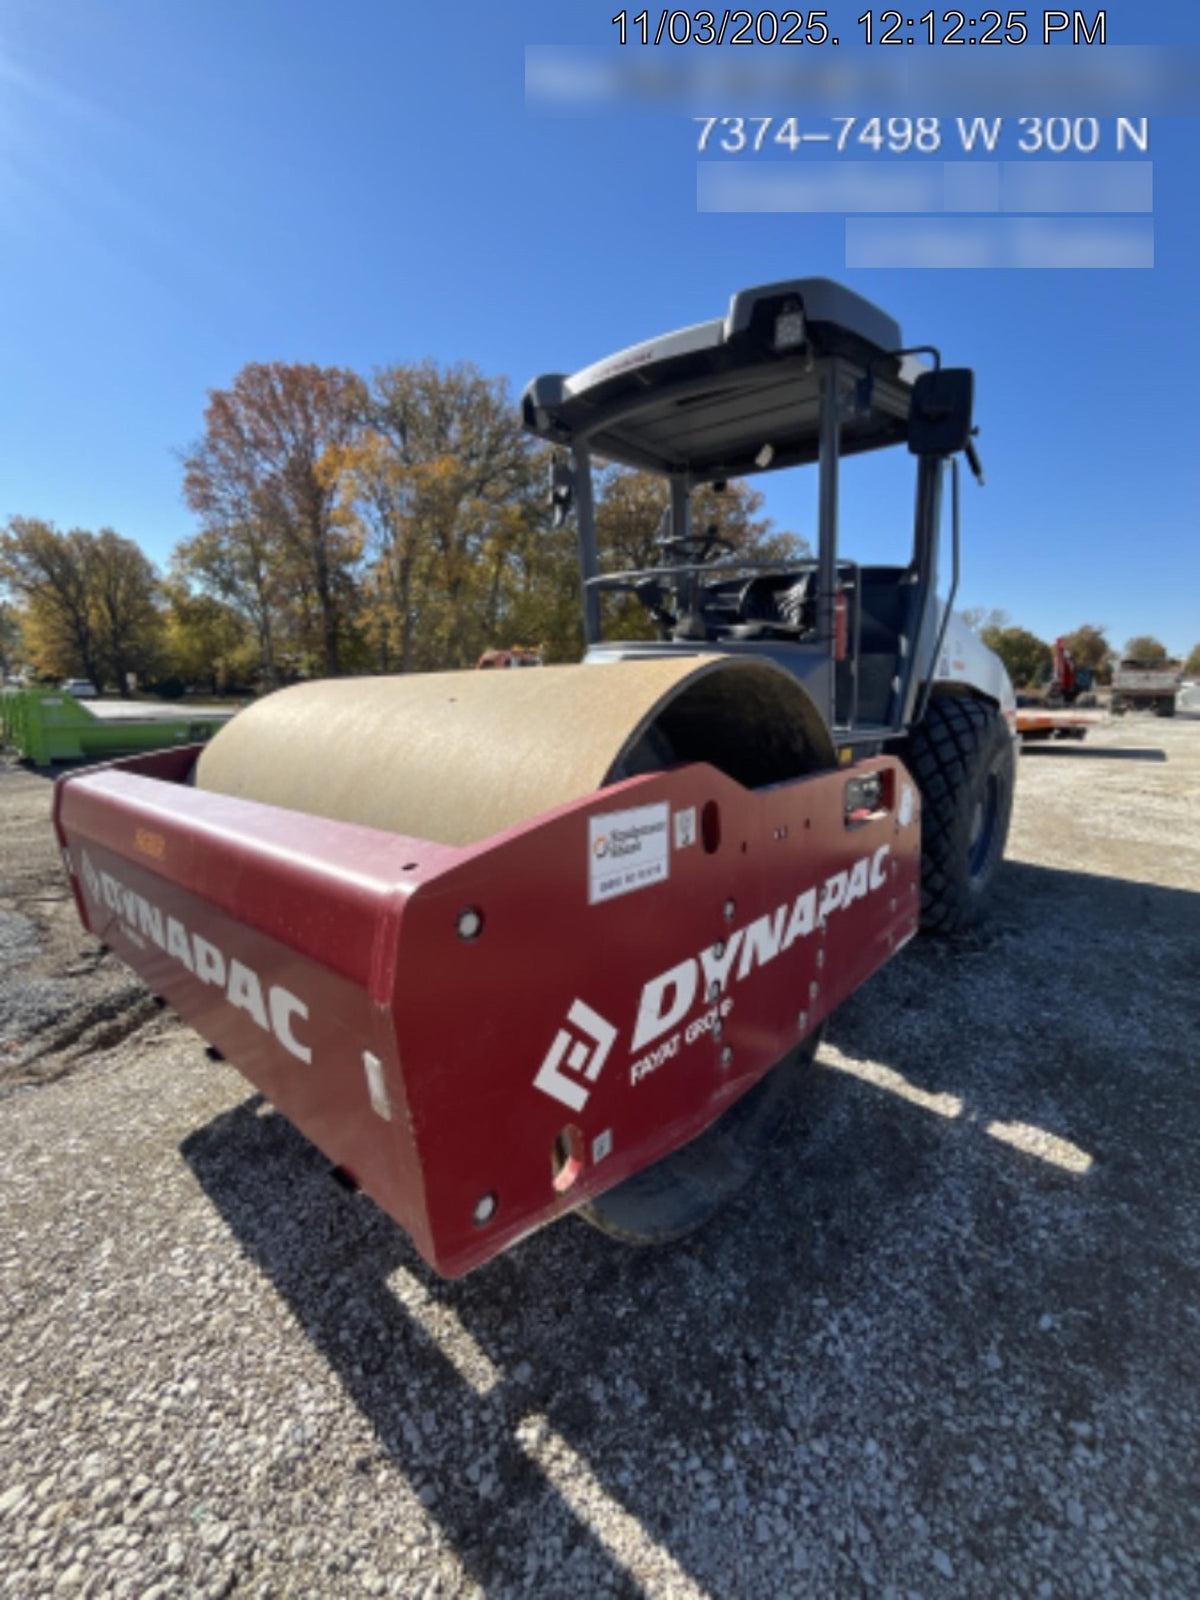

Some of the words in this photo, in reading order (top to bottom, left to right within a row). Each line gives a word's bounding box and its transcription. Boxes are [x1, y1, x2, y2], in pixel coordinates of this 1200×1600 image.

[100, 871, 312, 1065] DYNAPAC
[630, 844, 890, 1055] DYNAPAC
[629, 1034, 681, 1087] FAYAT
